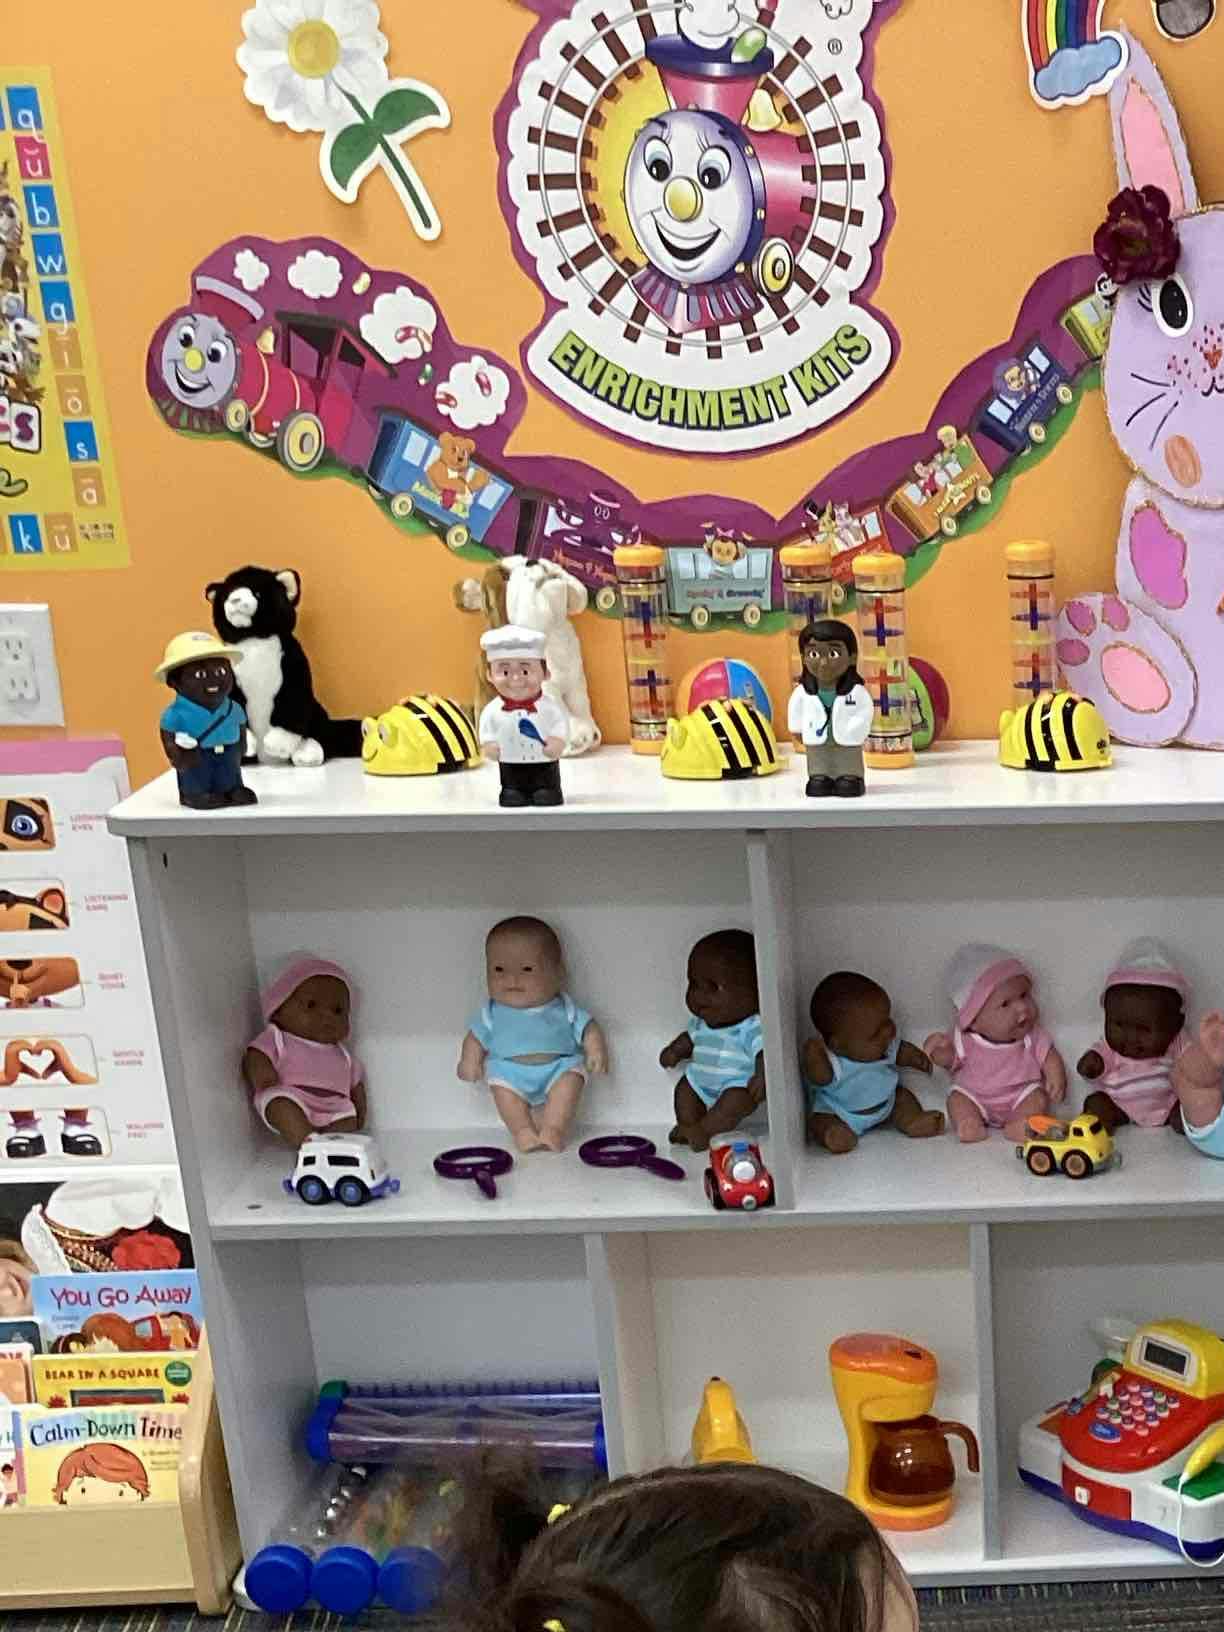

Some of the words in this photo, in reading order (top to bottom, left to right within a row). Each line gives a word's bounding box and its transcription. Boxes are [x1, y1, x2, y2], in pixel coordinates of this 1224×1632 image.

[31, 191, 51, 226] b
[547, 329, 793, 431] ENRICHMENT
[787, 323, 873, 406] KITS
[17, 518, 35, 553] k
[50, 1287, 92, 1310] You
[98, 1287, 129, 1308] Go
[134, 1284, 192, 1307] Away
[45, 1369, 74, 1381] BEAR
[78, 1369, 96, 1380] IN
[98, 1369, 108, 1380] A
[110, 1367, 160, 1381] SQUARE
[29, 1418, 136, 1447] Calm-Down
[140, 1416, 183, 1441] Time
